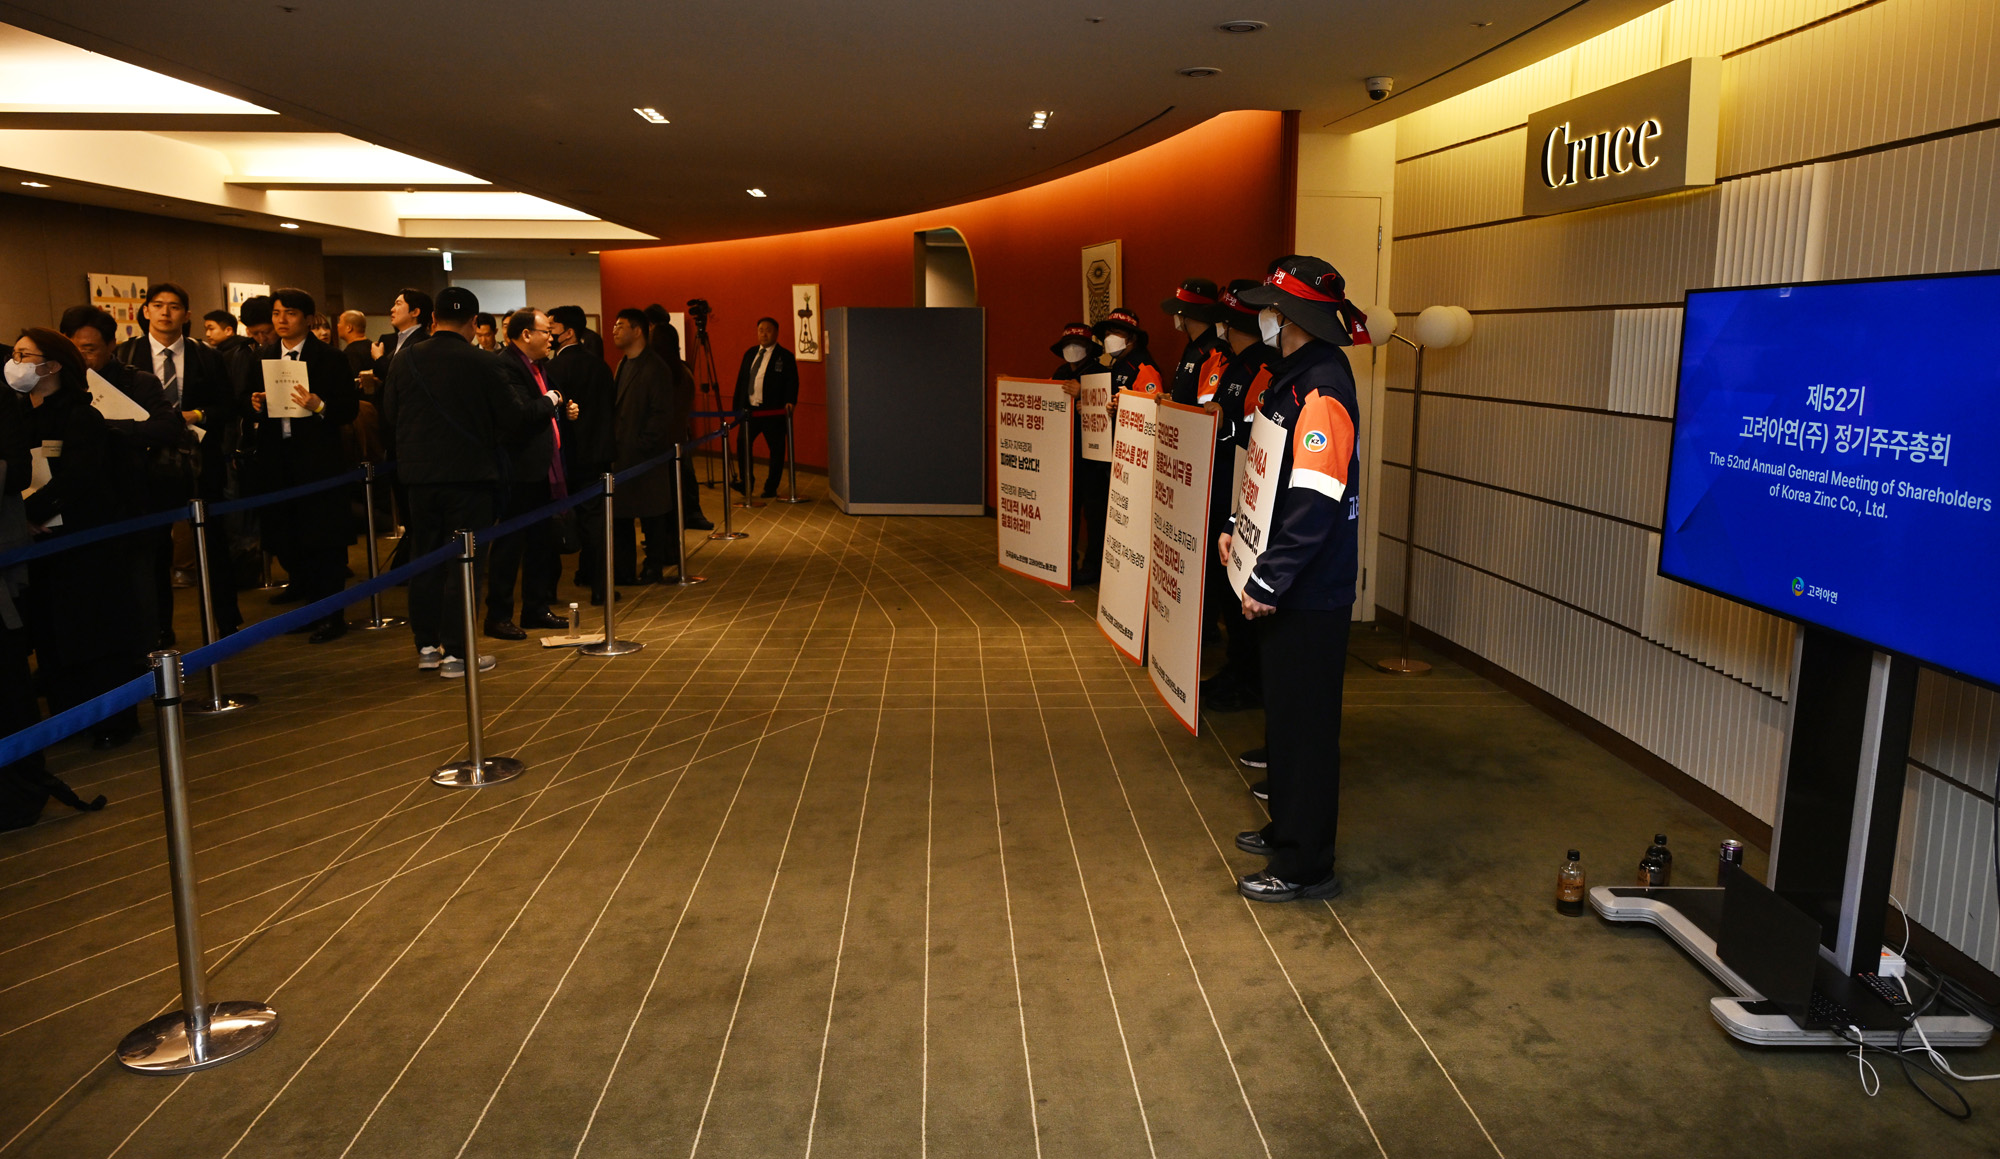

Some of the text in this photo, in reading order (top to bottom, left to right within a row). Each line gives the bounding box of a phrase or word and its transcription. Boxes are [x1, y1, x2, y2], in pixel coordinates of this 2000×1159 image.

[1540, 119, 1662, 189] Cruce
[1806, 383, 1866, 416] 제52기
[1000, 412, 1044, 431] MBK식 경영!
[1739, 415, 1951, 467] 고려아연(주) 정기주주총회
[1018, 456, 1040, 473] 남았다!
[1136, 447, 1149, 469] 망친
[1709, 451, 1992, 512] The 52nd Annual General Meeting of Shareholders
[1001, 497, 1041, 520] 적대적 M&A
[1769, 483, 1888, 519] of Korea Zinc Co., Ltd.
[1807, 584, 1838, 605] 고려아연
